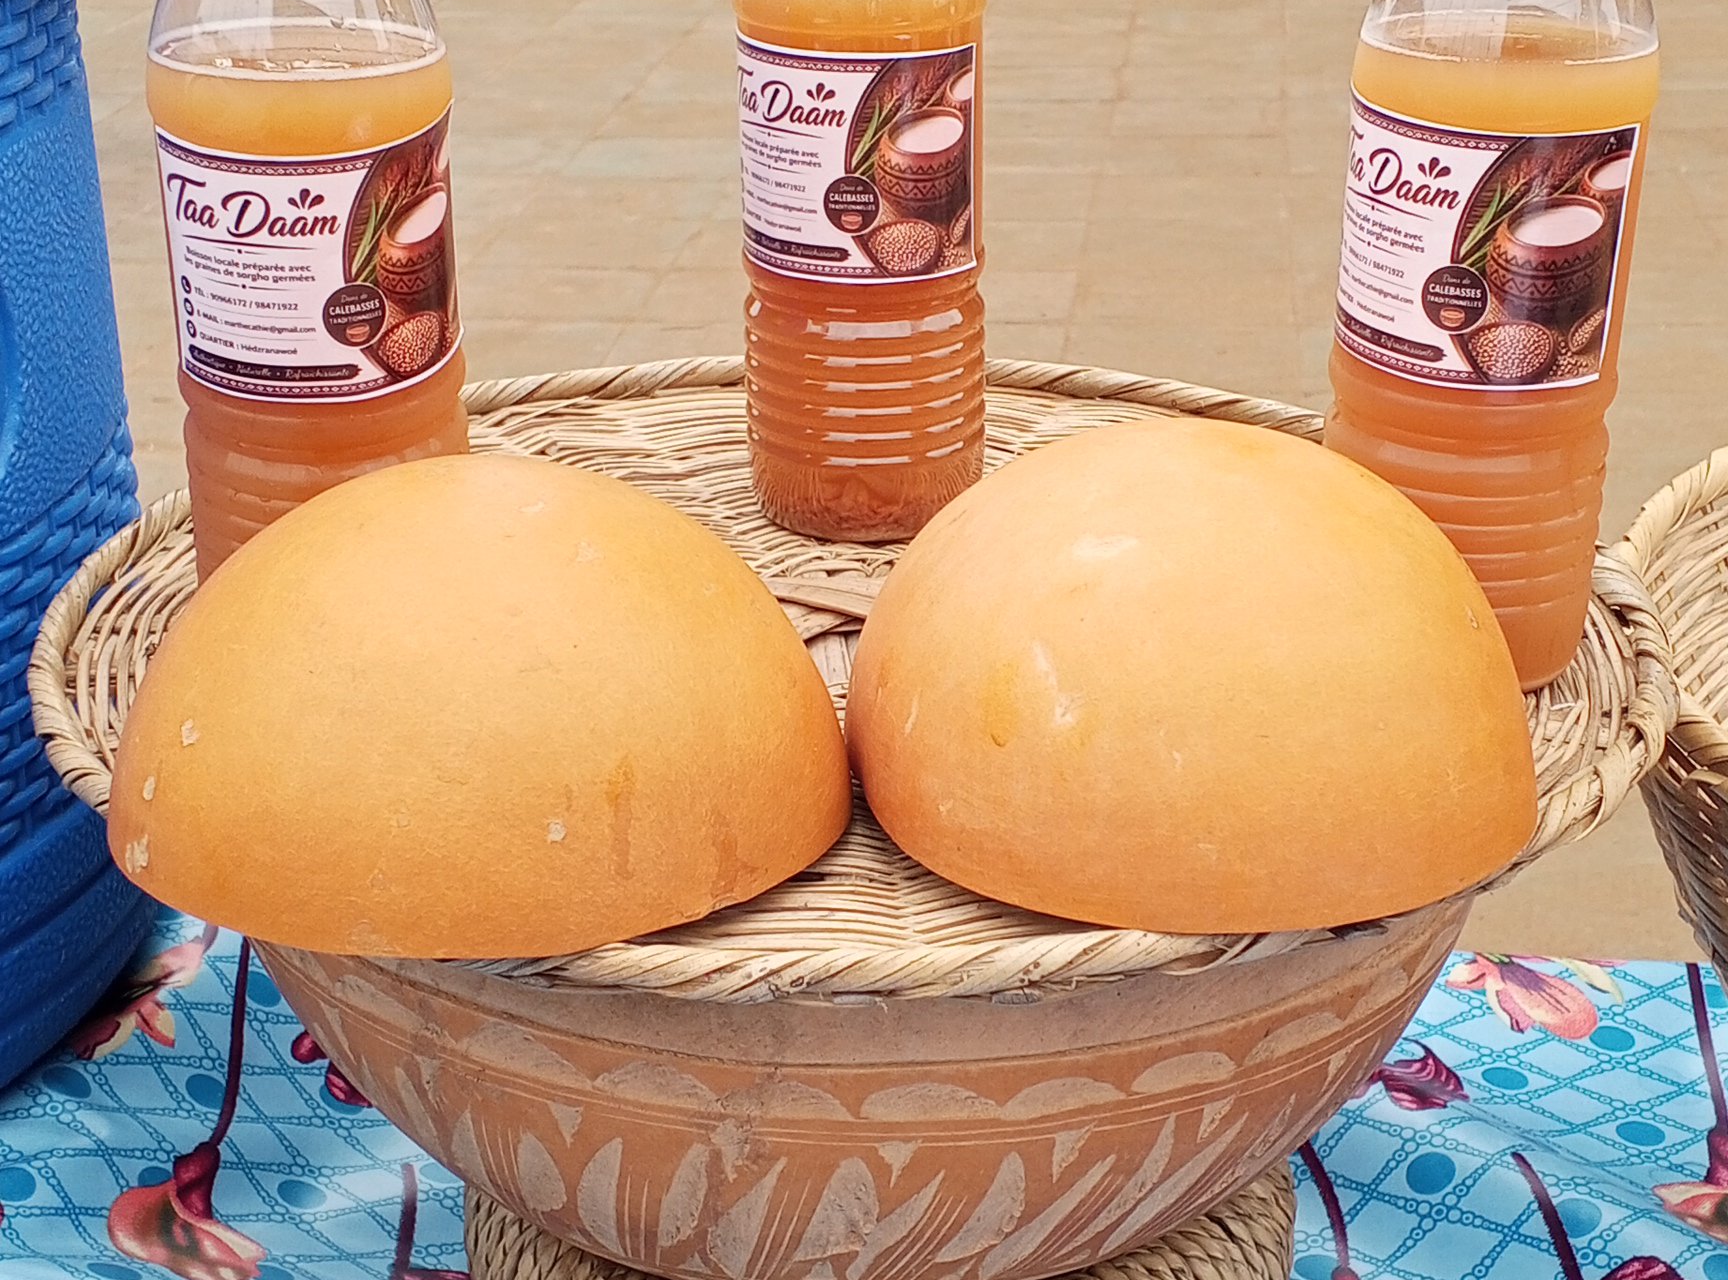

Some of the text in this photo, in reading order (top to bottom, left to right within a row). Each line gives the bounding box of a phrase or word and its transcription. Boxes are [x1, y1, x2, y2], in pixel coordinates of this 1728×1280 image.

[761, 80, 847, 128] Daam
[1369, 147, 1460, 210] Daam
[167, 173, 340, 238] Taa Daam
[829, 193, 874, 202] CALEBASSES
[1390, 237, 1424, 253] germées
[1404, 232, 1423, 243] avec
[195, 261, 221, 275] graines
[237, 272, 269, 282] sorgho
[272, 274, 315, 283] germées
[214, 256, 239, 267] locale
[243, 262, 285, 273] préparée
[1429, 284, 1481, 298] CALEBASSES
[255, 301, 298, 310] 98471922
[329, 299, 379, 315] CALEBASSES
[1427, 295, 1482, 308] TRADITIONNELLES
[200, 332, 234, 348] QUARTIER
